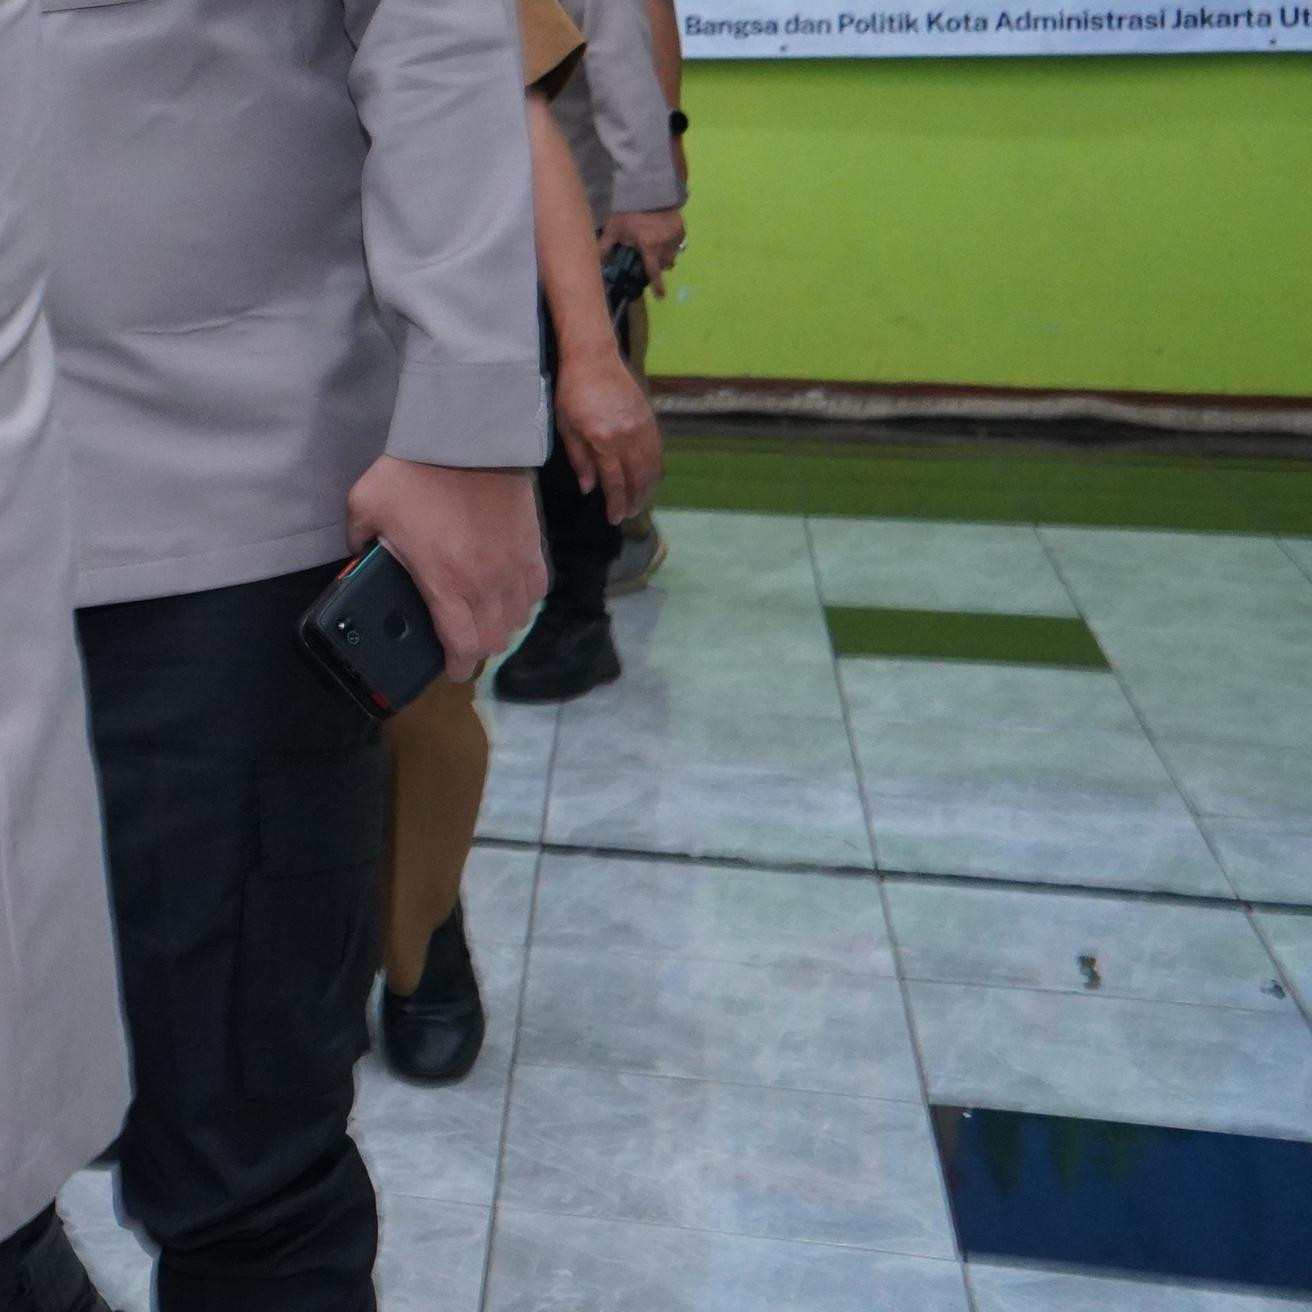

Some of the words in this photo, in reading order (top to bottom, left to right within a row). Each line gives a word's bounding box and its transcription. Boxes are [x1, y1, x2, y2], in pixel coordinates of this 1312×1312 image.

[685, 14, 778, 40] Bangsa
[784, 12, 832, 34] dan
[838, 11, 919, 34] Politik
[927, 11, 989, 32] Kota
[995, 8, 1166, 31] Administrasi
[1172, 6, 1272, 30] Jakarta
